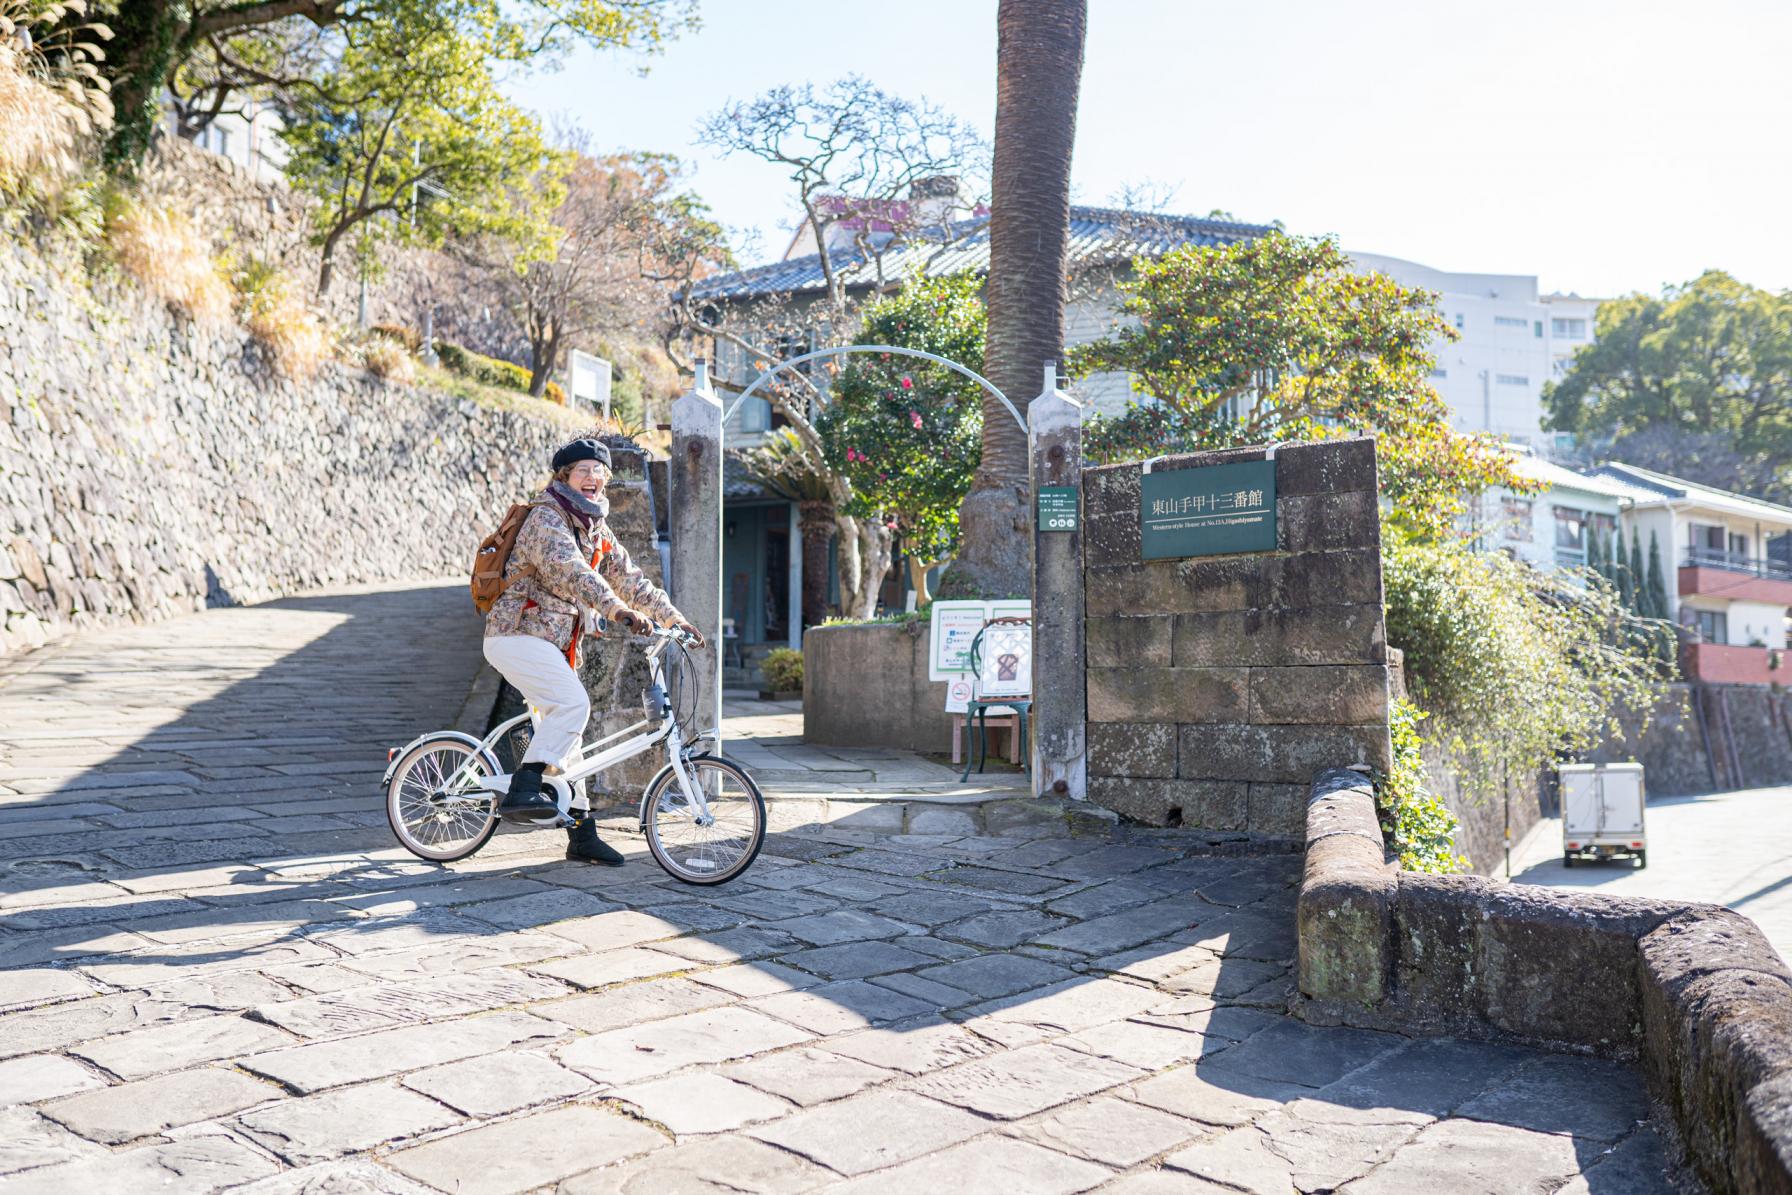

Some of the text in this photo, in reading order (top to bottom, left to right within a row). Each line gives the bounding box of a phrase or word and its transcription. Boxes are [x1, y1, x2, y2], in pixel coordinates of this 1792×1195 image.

[1152, 489, 1263, 516] 東山手甲十三番館
